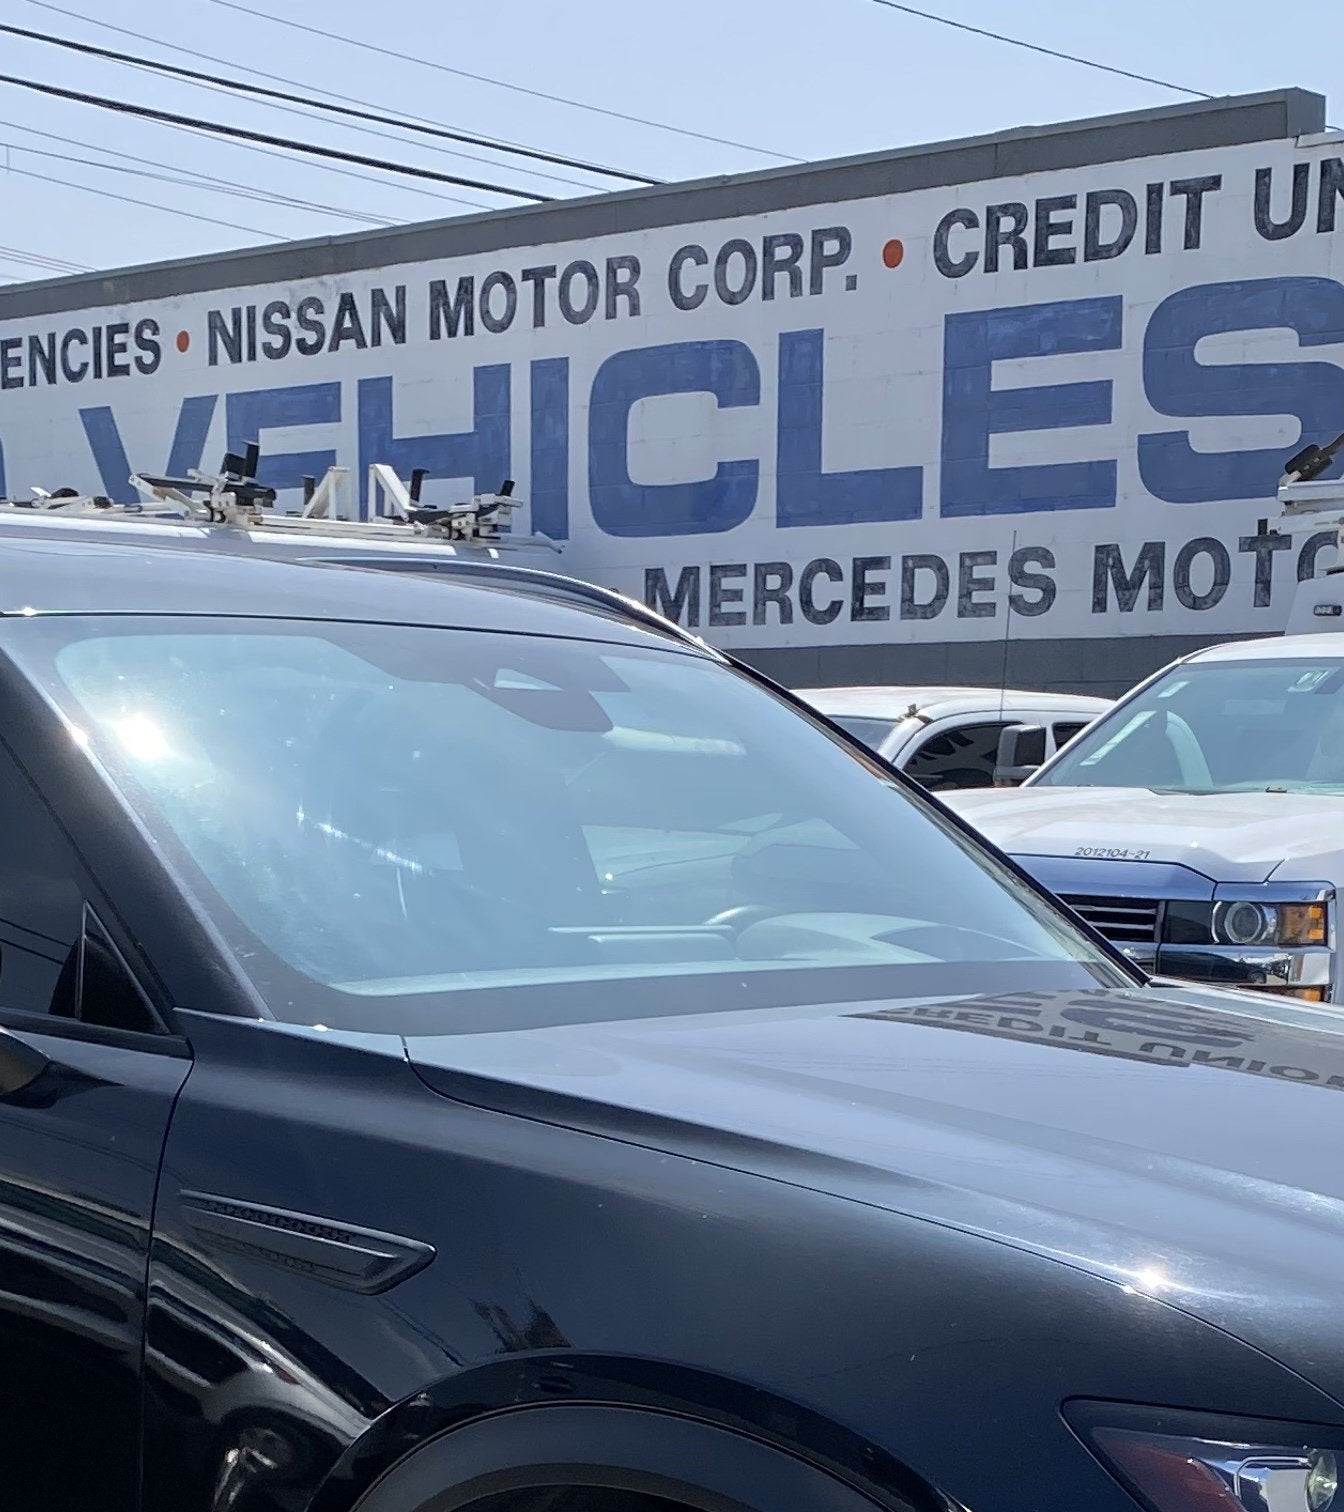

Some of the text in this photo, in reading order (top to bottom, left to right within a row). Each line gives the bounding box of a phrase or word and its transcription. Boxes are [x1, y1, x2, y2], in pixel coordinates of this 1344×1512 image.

[207, 284, 407, 367] NISSAN
[429, 254, 642, 341] MOTOR
[667, 225, 859, 312] CORP.
[932, 174, 1222, 279] CREDIT
[644, 545, 1058, 629] MERCEDES
[1074, 846, 1151, 860] 2012104-21
